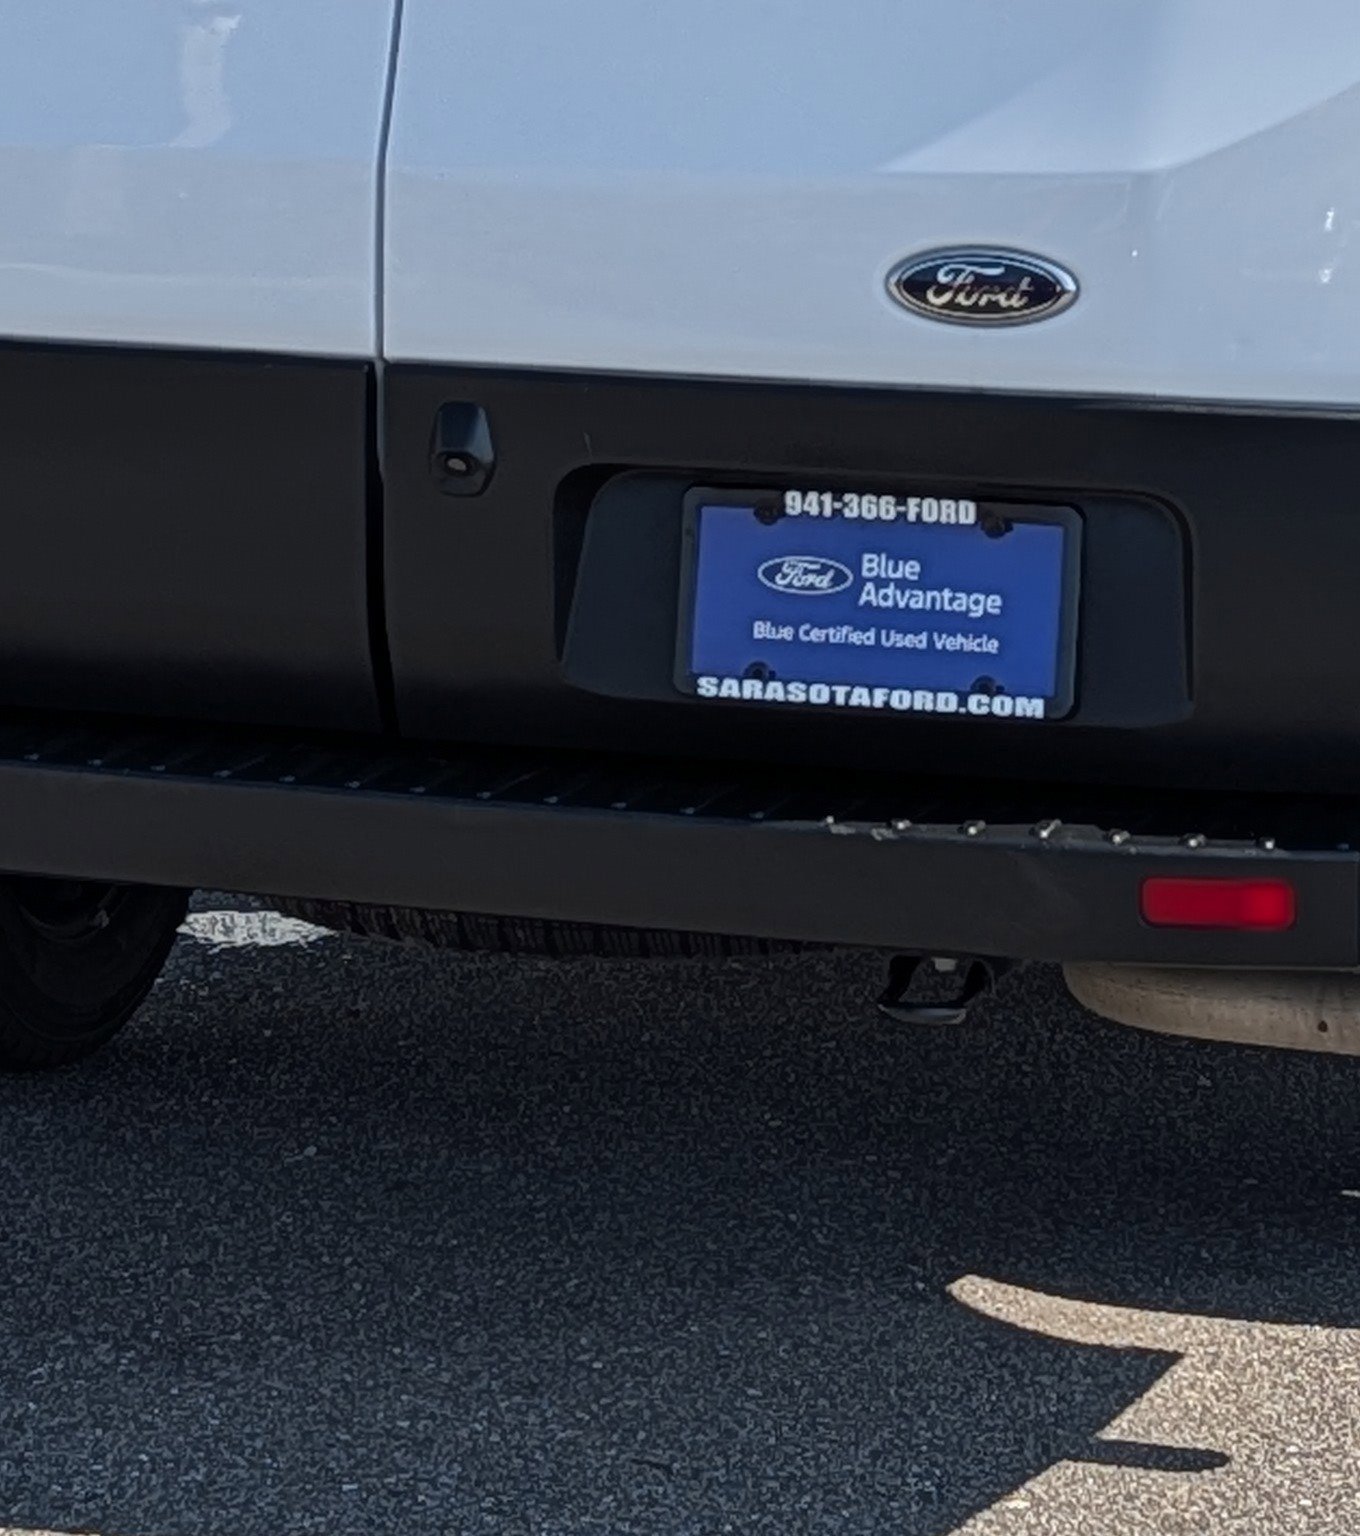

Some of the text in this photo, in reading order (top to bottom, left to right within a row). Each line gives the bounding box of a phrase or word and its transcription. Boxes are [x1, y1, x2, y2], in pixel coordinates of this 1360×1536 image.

[784, 491, 977, 524] 941-366-FORD
[774, 560, 836, 590] Ford
[861, 553, 921, 581] Blue
[859, 583, 1002, 617] Advantage
[753, 620, 999, 655] Blue Certified Used Vehicle
[697, 676, 1045, 719] SARASOTAFORD.COM
